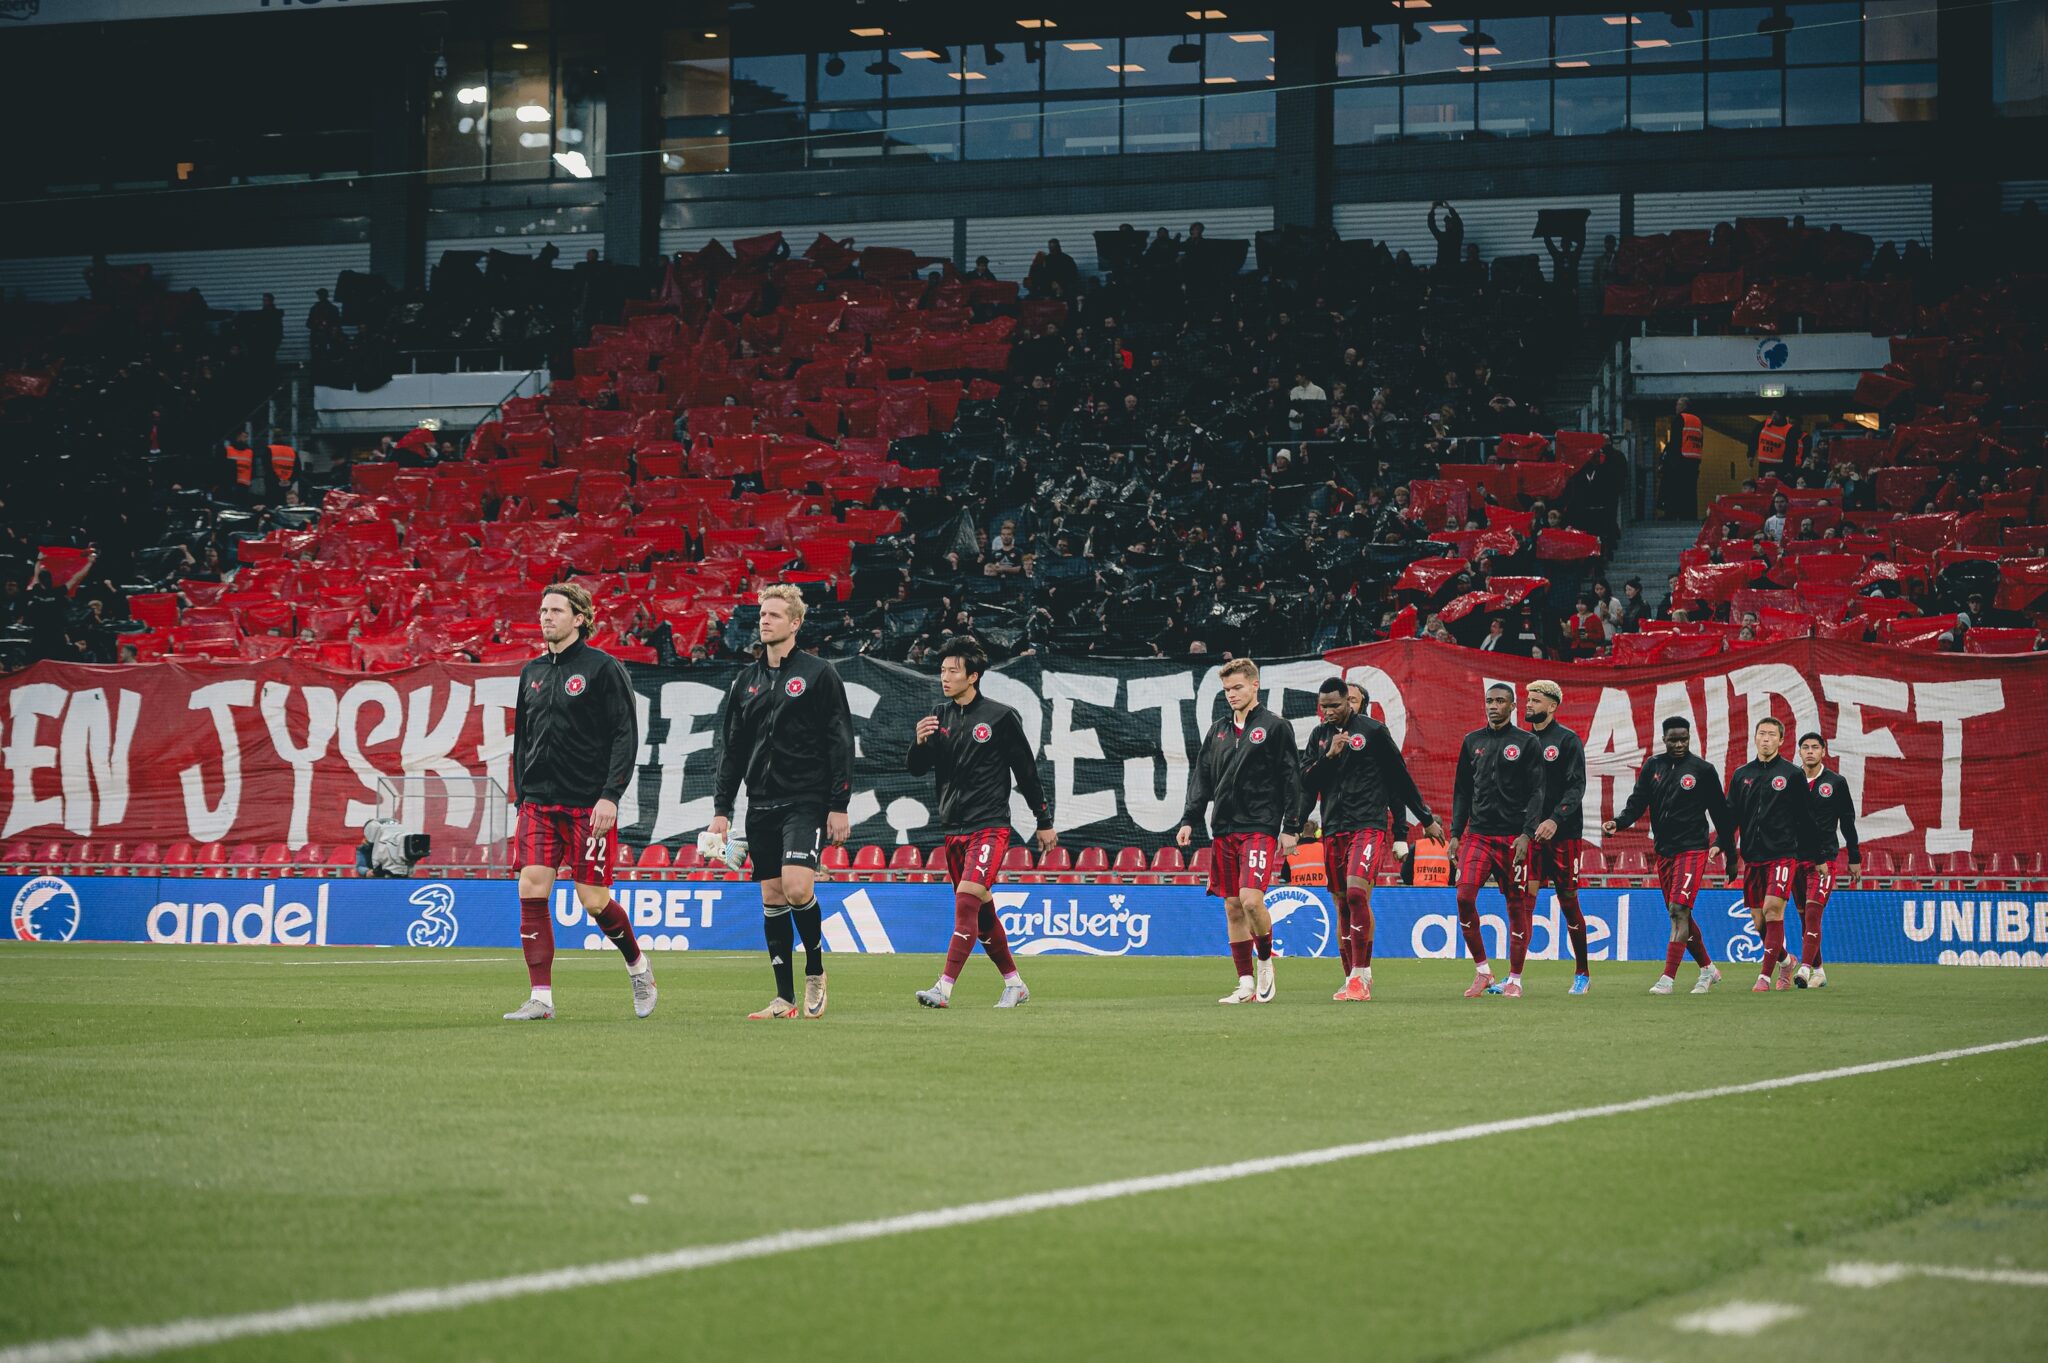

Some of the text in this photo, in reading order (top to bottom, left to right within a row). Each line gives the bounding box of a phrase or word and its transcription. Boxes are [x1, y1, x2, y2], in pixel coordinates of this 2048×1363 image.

[0, 682, 142, 838] EN
[1483, 663, 2005, 854] ANDET
[815, 827, 821, 850] 1
[585, 837, 607, 862] 22
[979, 844, 990, 864] 3
[1363, 844, 1372, 860] 4
[1249, 850, 1267, 869] 55
[1292, 872, 1324, 883] EWARD
[1416, 866, 1446, 874] STEWARD
[1514, 865, 1528, 882] 21
[1775, 866, 1789, 882] 10
[1683, 873, 1692, 889] 7
[147, 883, 329, 945] andel
[1411, 894, 1630, 961] andel
